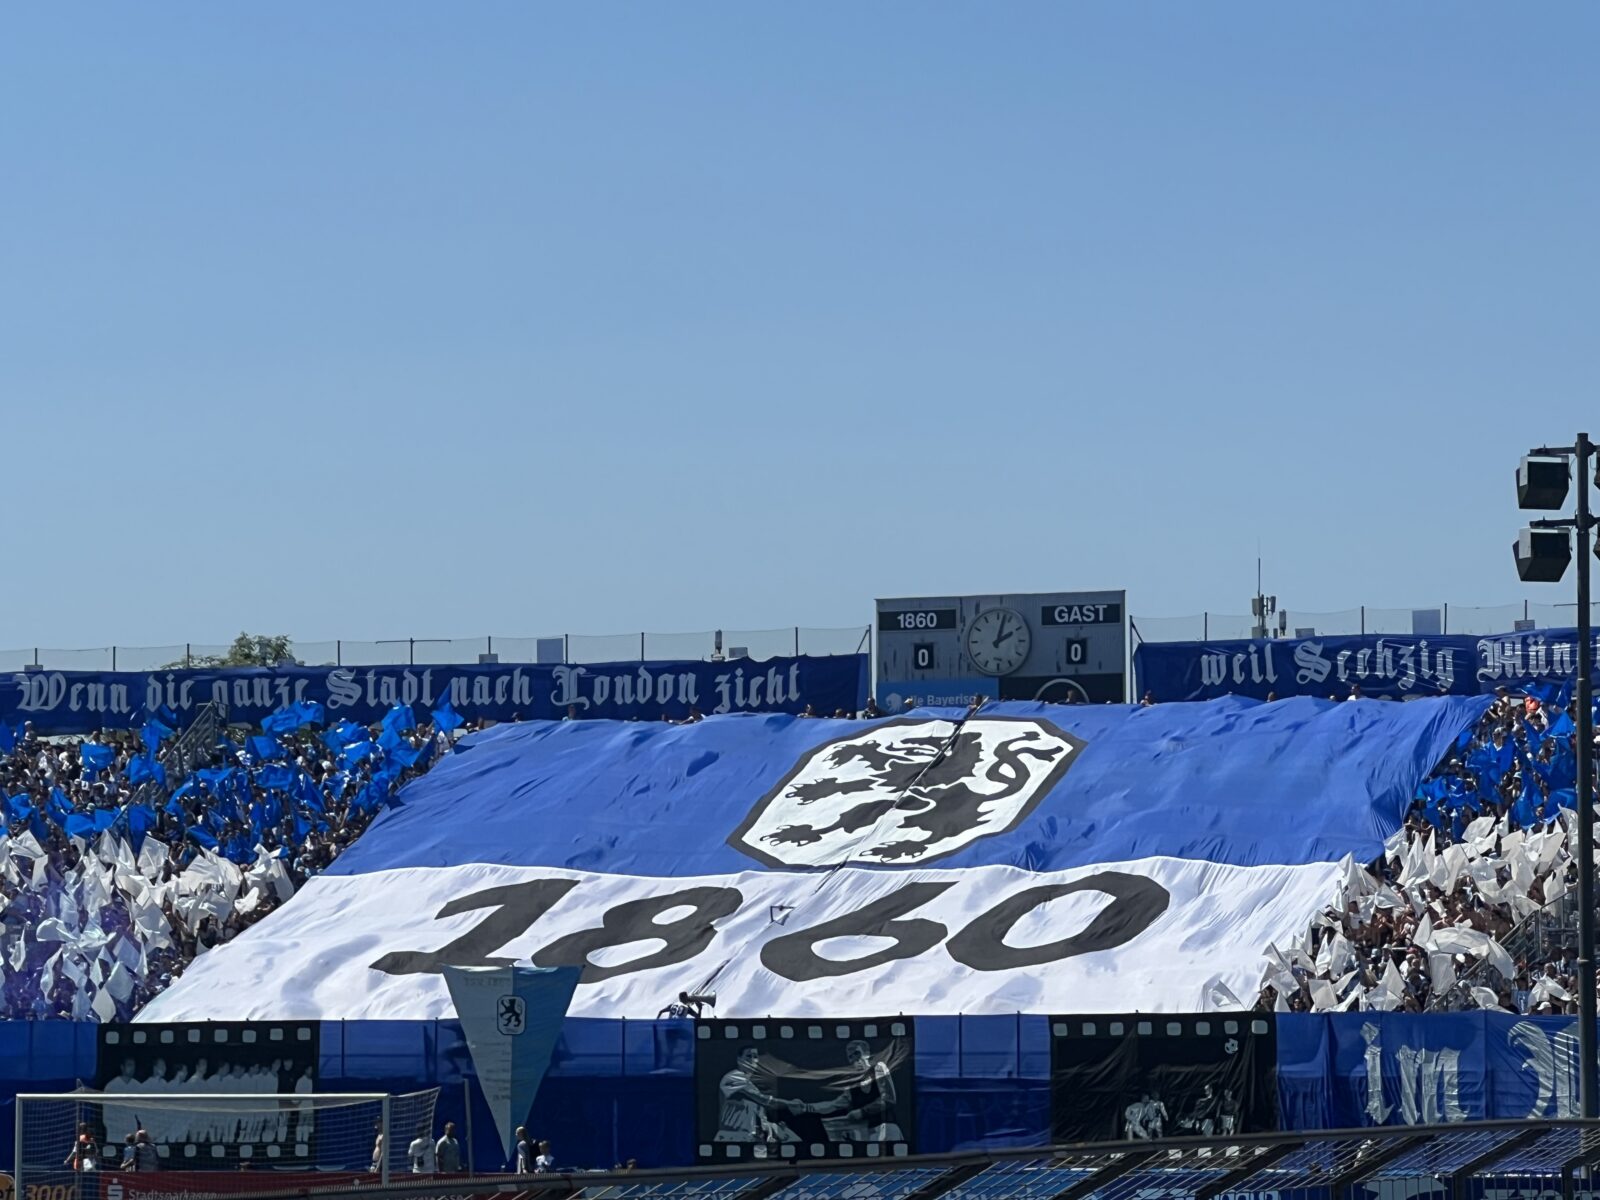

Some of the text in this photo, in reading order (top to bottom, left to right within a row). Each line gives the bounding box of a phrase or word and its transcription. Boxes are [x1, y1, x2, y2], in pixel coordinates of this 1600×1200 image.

[897, 612, 937, 629] 1860
[1054, 605, 1107, 622] GAST
[918, 649, 928, 666] 0
[1071, 644, 1081, 661] 0
[1200, 642, 1278, 686] weil
[16, 672, 131, 713] Wenn
[146, 673, 195, 711] die
[326, 668, 436, 709] Stadt
[450, 666, 533, 707] nach
[551, 665, 700, 709] London
[370, 869, 1170, 984] 1860
